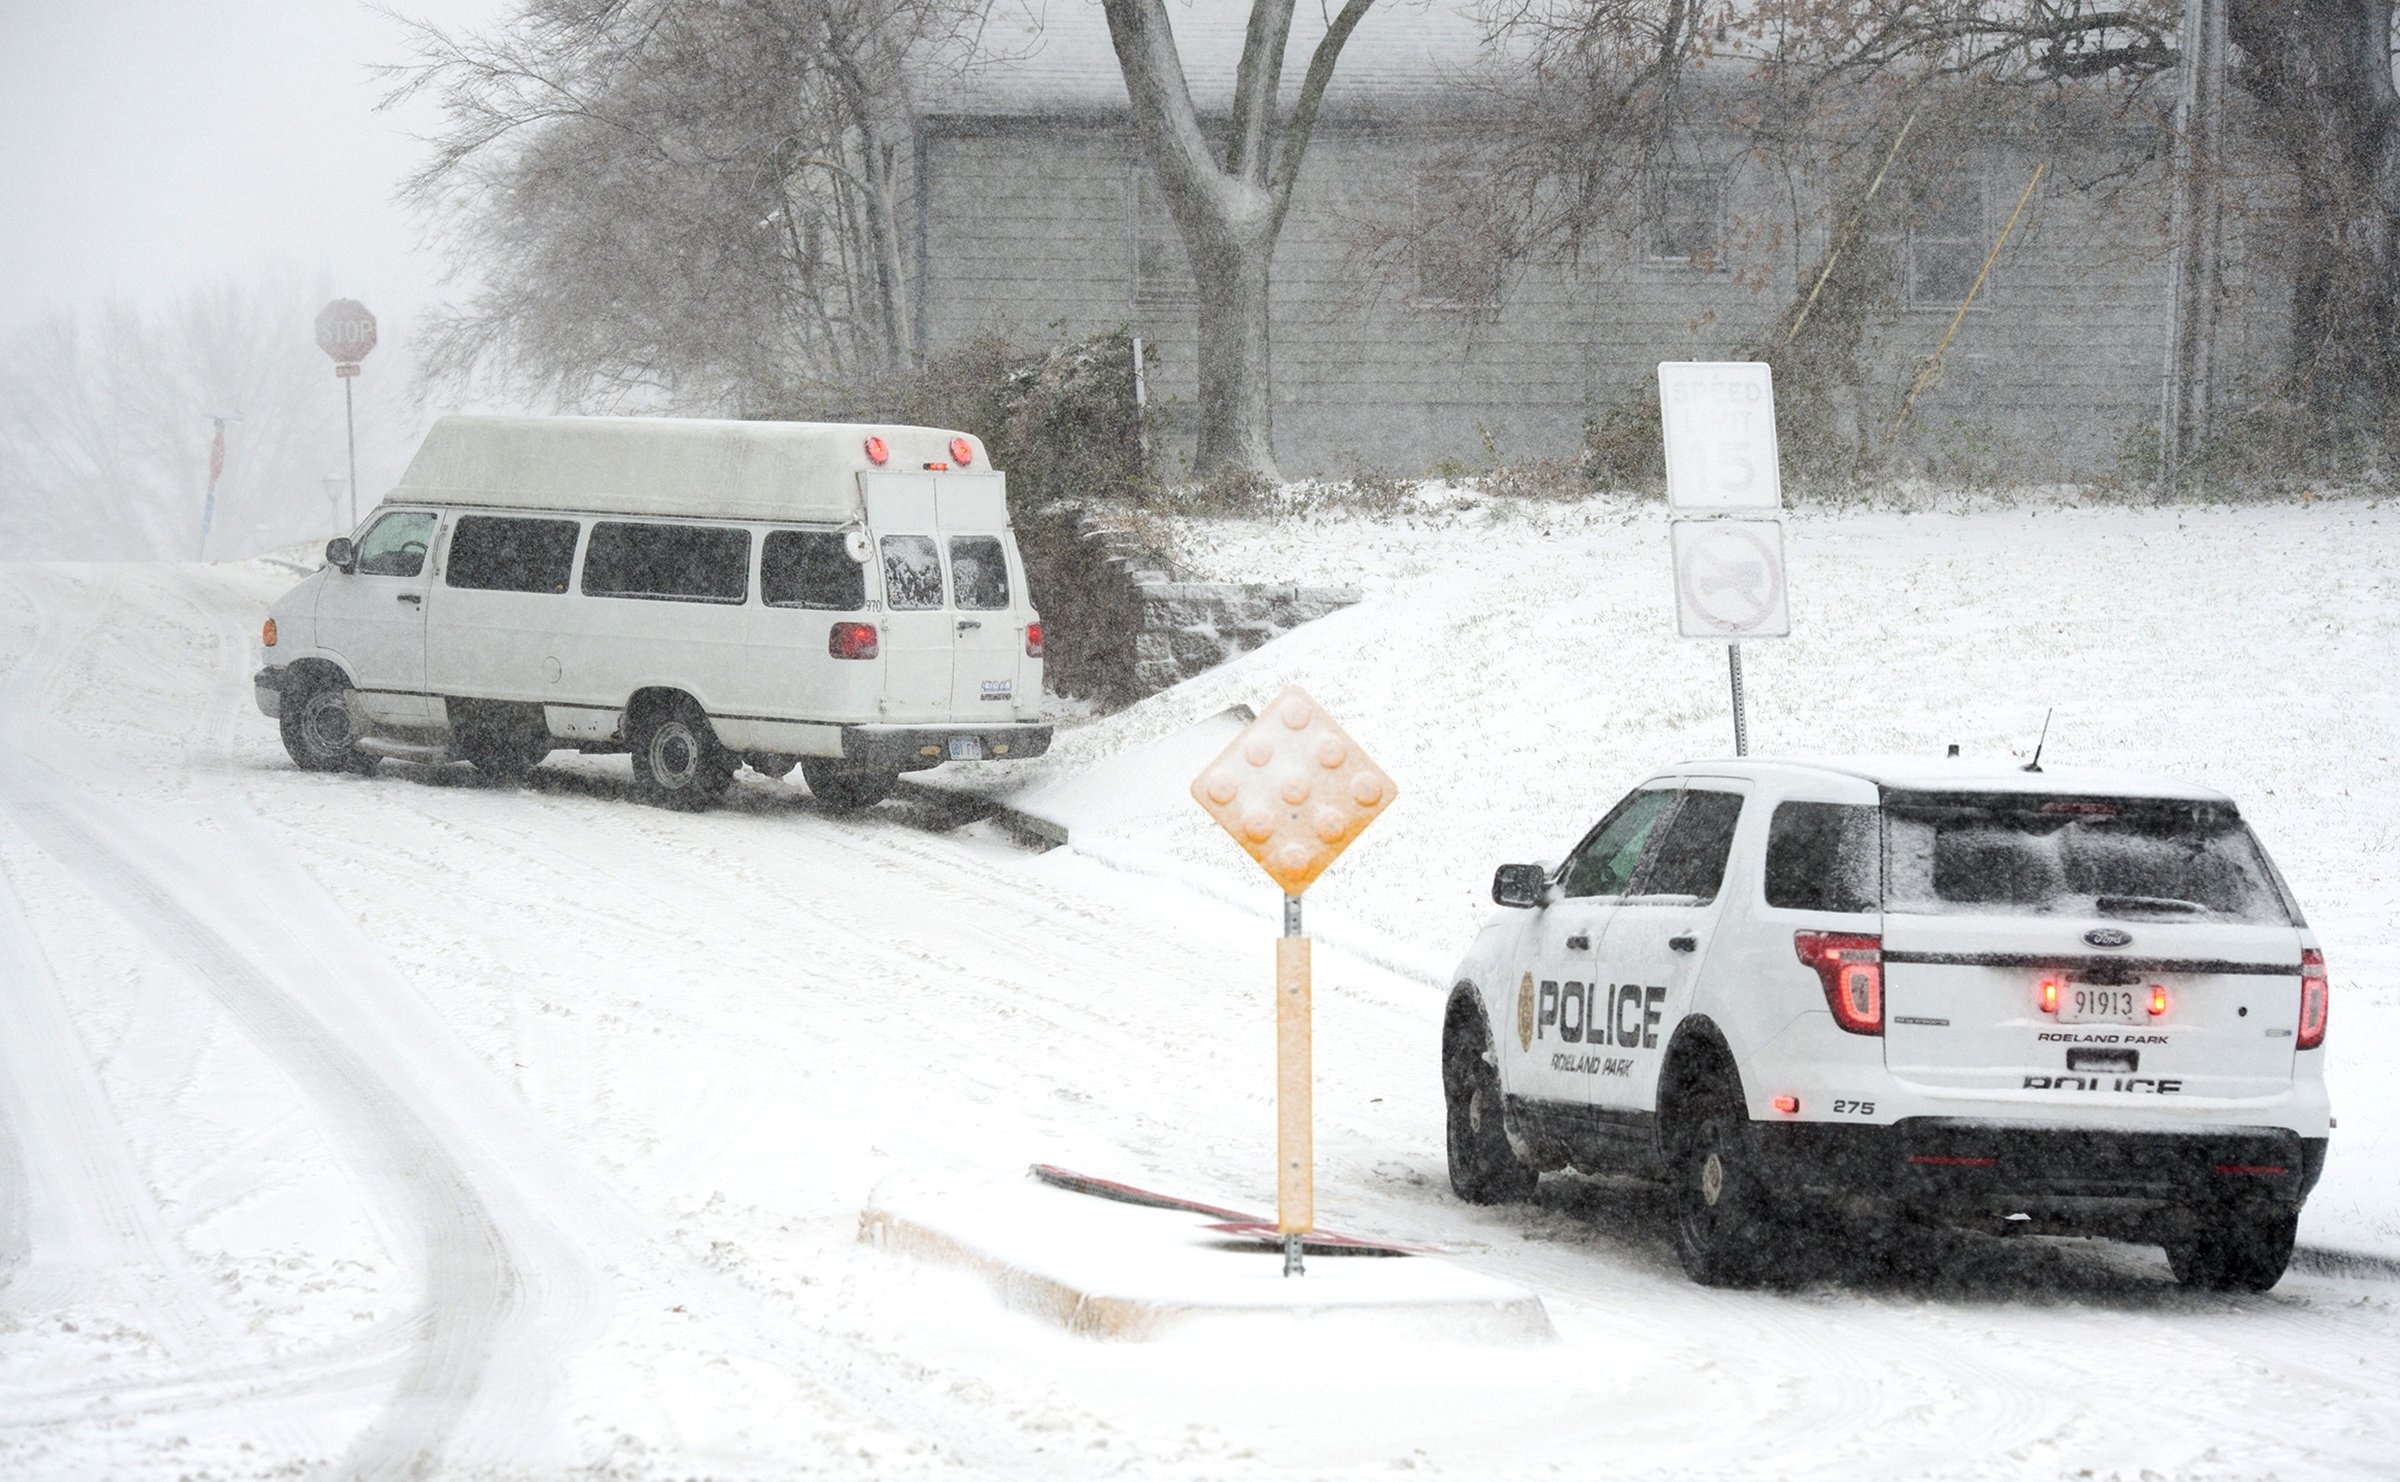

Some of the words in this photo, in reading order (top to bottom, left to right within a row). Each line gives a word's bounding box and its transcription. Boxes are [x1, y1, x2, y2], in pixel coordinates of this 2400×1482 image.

[322, 319, 373, 343] STOP
[1672, 381, 1761, 402] SPEED
[1688, 440, 1755, 493] 15
[865, 599, 883, 613] 970
[1537, 980, 1667, 1049] POLICE
[2075, 990, 2133, 1015] 91913
[2037, 1032, 2119, 1044] ROELAND
[2124, 1034, 2169, 1045] PARK
[1551, 1053, 1601, 1074] ROELAND
[1602, 1057, 1634, 1077] PARK
[1833, 1099, 1875, 1115] 275
